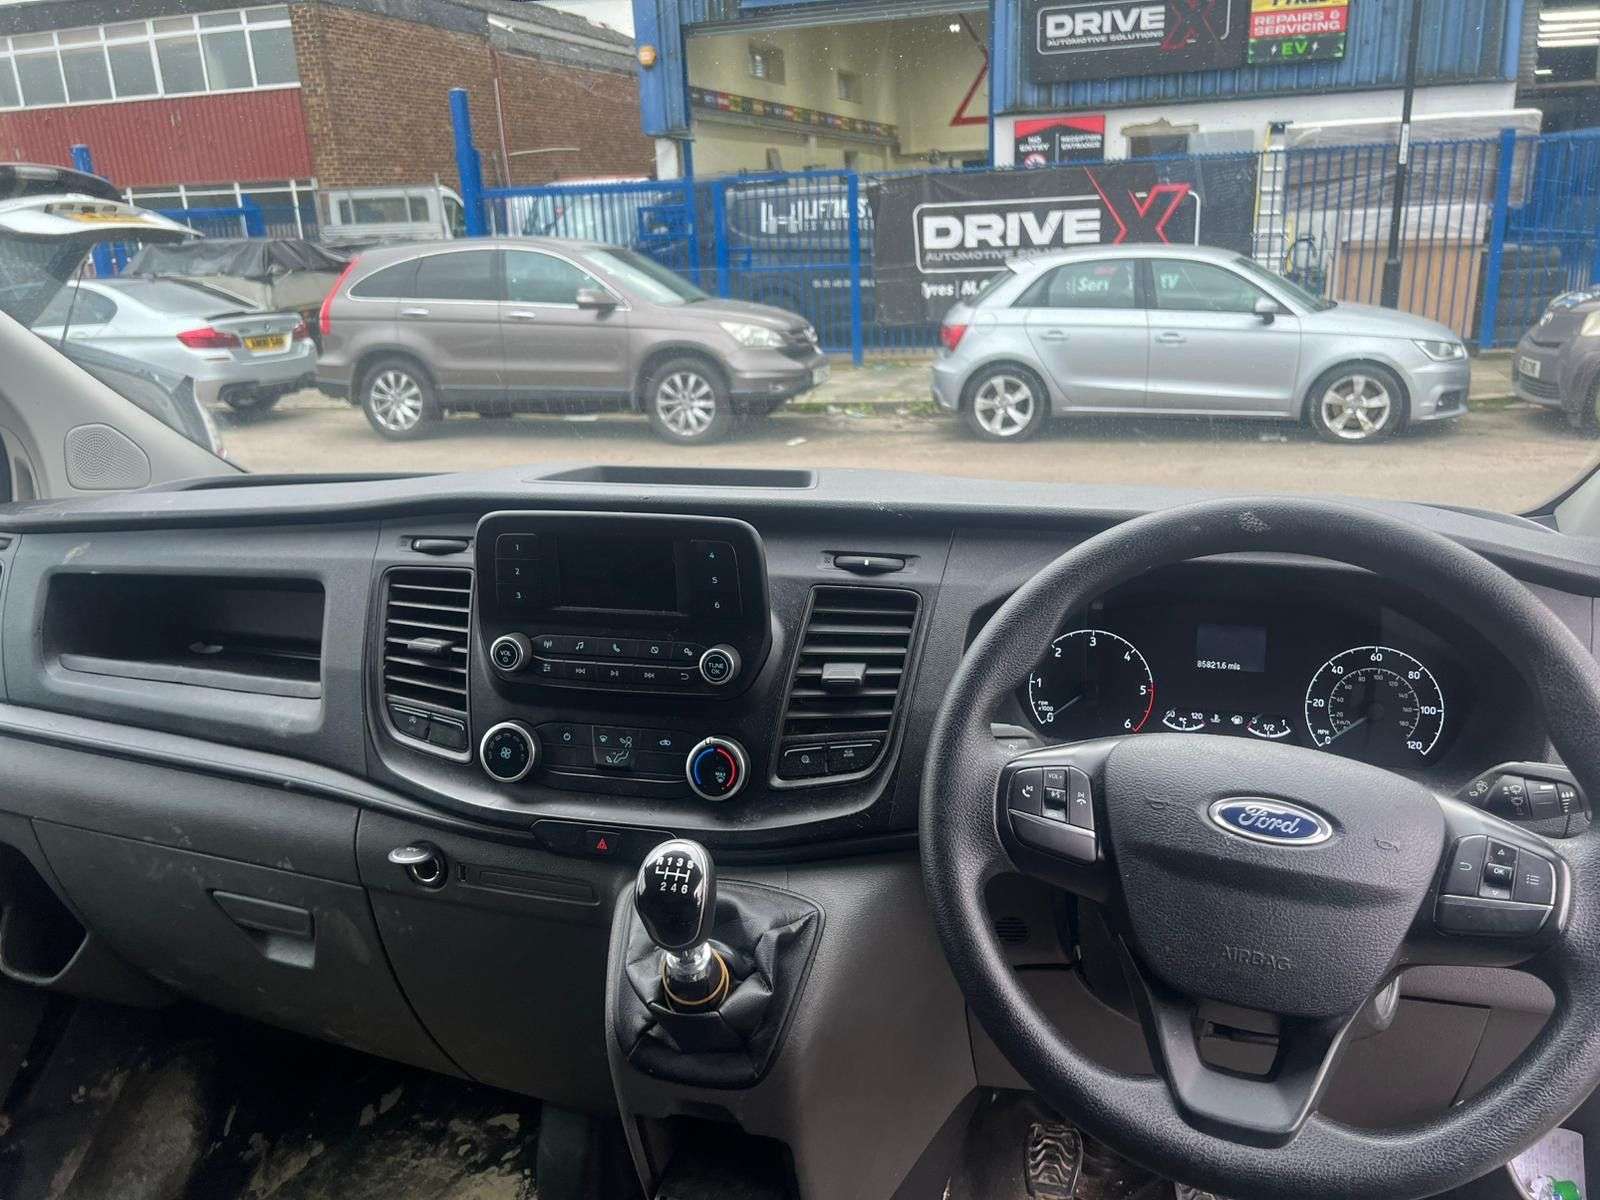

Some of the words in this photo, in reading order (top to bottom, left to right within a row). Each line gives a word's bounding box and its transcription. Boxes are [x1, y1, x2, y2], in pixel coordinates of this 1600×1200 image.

[1046, 5, 1166, 38] DRIVE
[1254, 11, 1324, 26] REPAIRS
[1254, 20, 1340, 36] SERVICING
[1047, 36, 1108, 47] AUTOMOTIVE
[1109, 30, 1165, 42] SOLUTIONS
[1281, 41, 1308, 56] EV
[922, 208, 1101, 249] DRIVE
[514, 567, 521, 576] 2
[711, 576, 718, 584] 5
[713, 601, 720, 609] 6
[1089, 636, 1097, 647] 3
[1054, 647, 1062, 658] 2
[1123, 651, 1131, 662] 4
[1370, 653, 1383, 662] 60
[708, 662, 724, 670] TUNE
[1197, 660, 1227, 670] 85821.6
[1331, 665, 1344, 675] 40
[1407, 670, 1421, 680] 80
[1036, 677, 1042, 688] 1
[1139, 685, 1147, 695] 5
[1312, 699, 1325, 707] 20
[1420, 705, 1437, 715] 100
[1190, 712, 1203, 720] 120
[1124, 718, 1132, 728] 6
[1262, 723, 1275, 731] 1/2
[1406, 740, 1423, 750] 120
[1238, 805, 1300, 835] Ford
[667, 857, 673, 866] 1
[676, 858, 684, 867] 3
[1493, 867, 1505, 875] OK
[660, 881, 667, 891] 2
[670, 883, 677, 893] 4
[680, 884, 688, 894] 6
[1221, 944, 1292, 970] AIRBAG
